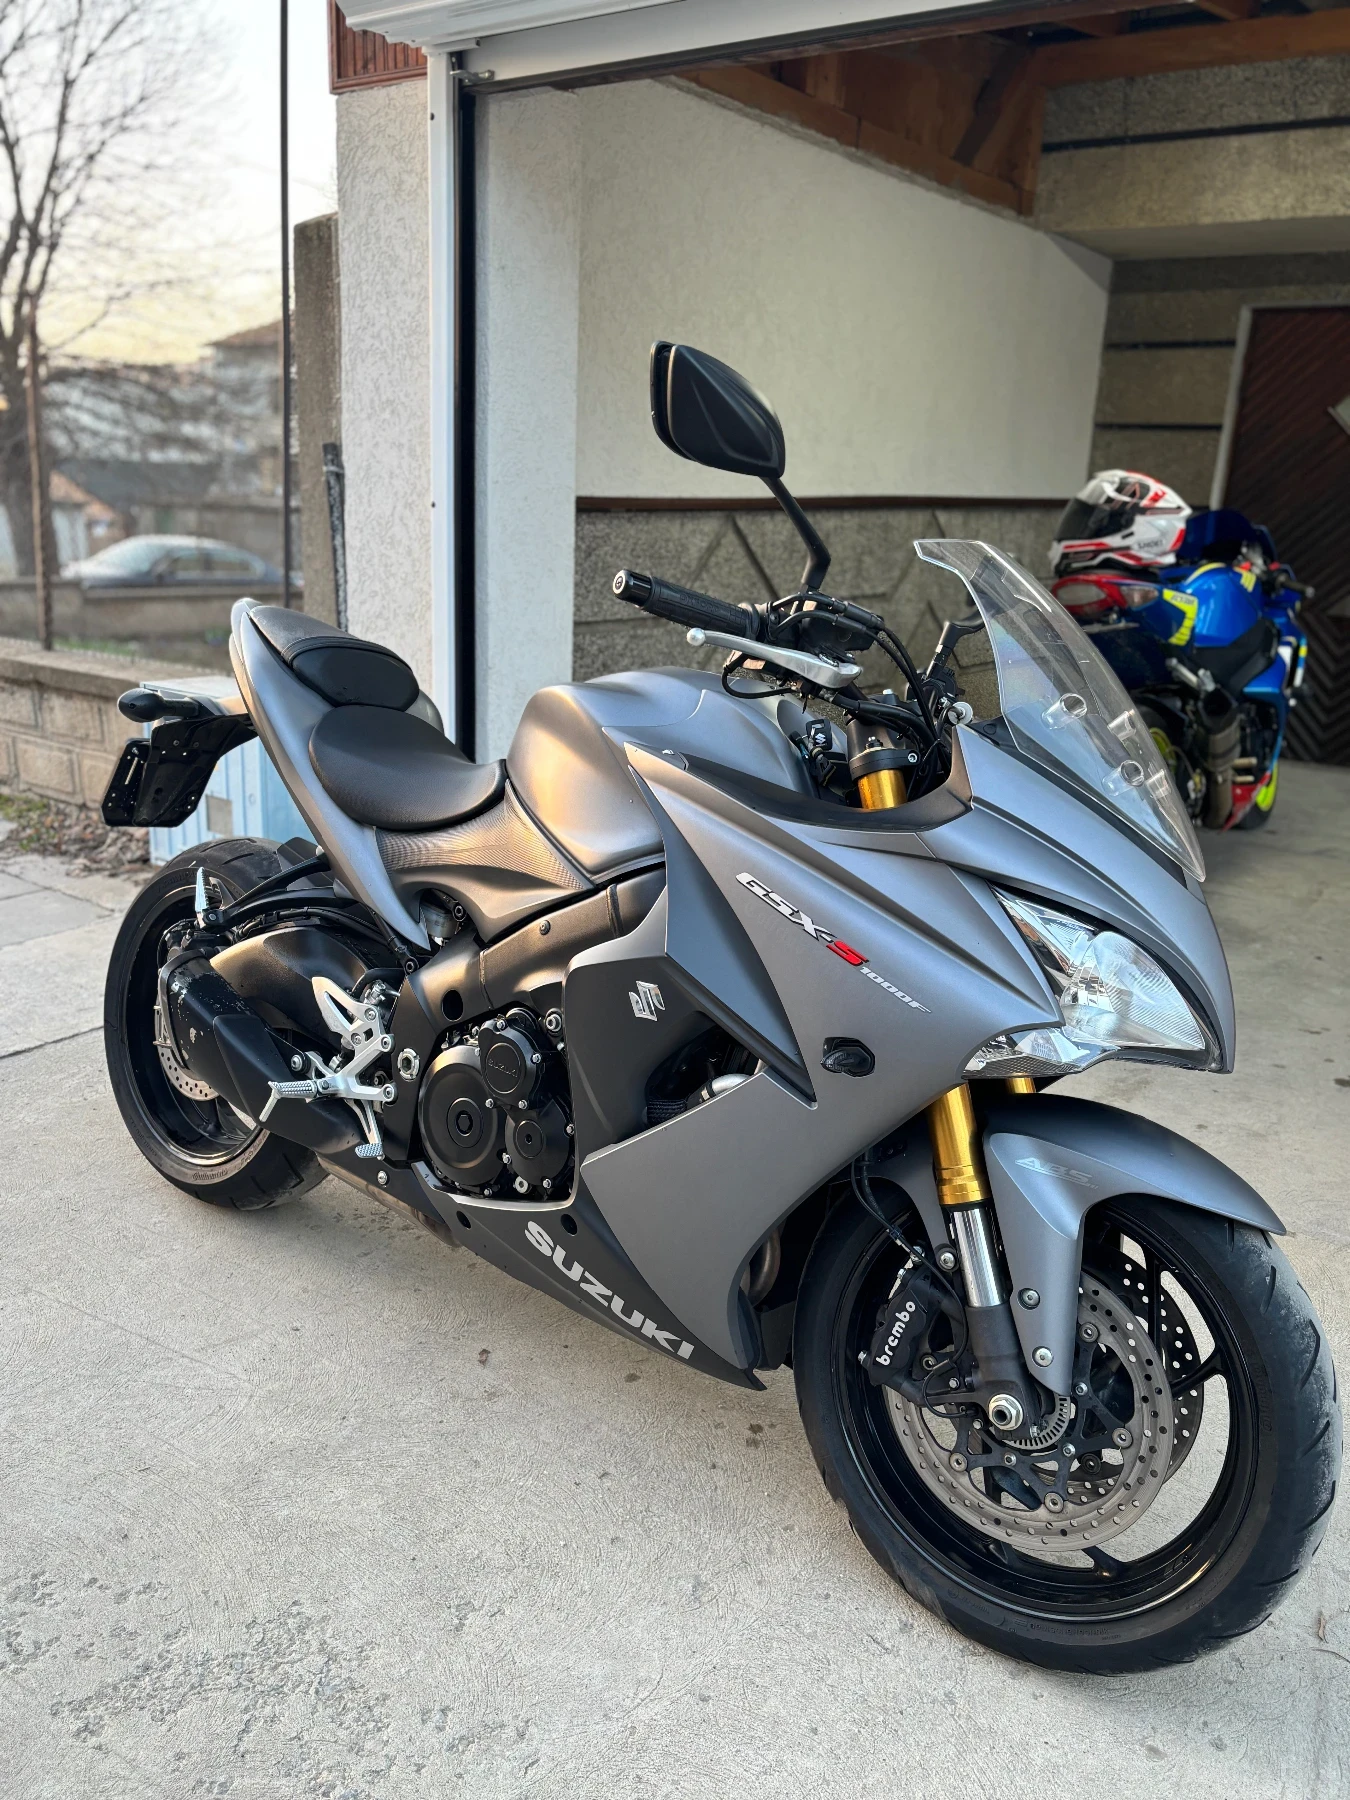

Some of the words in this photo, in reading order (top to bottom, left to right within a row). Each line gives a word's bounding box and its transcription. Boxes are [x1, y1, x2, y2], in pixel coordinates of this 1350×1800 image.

[735, 872, 870, 967] GSX-S
[859, 965, 932, 1014] 1000F
[1015, 1157, 1093, 1185] ABS
[524, 1220, 695, 1360] SUZUKI
[875, 1301, 916, 1366] brembo
